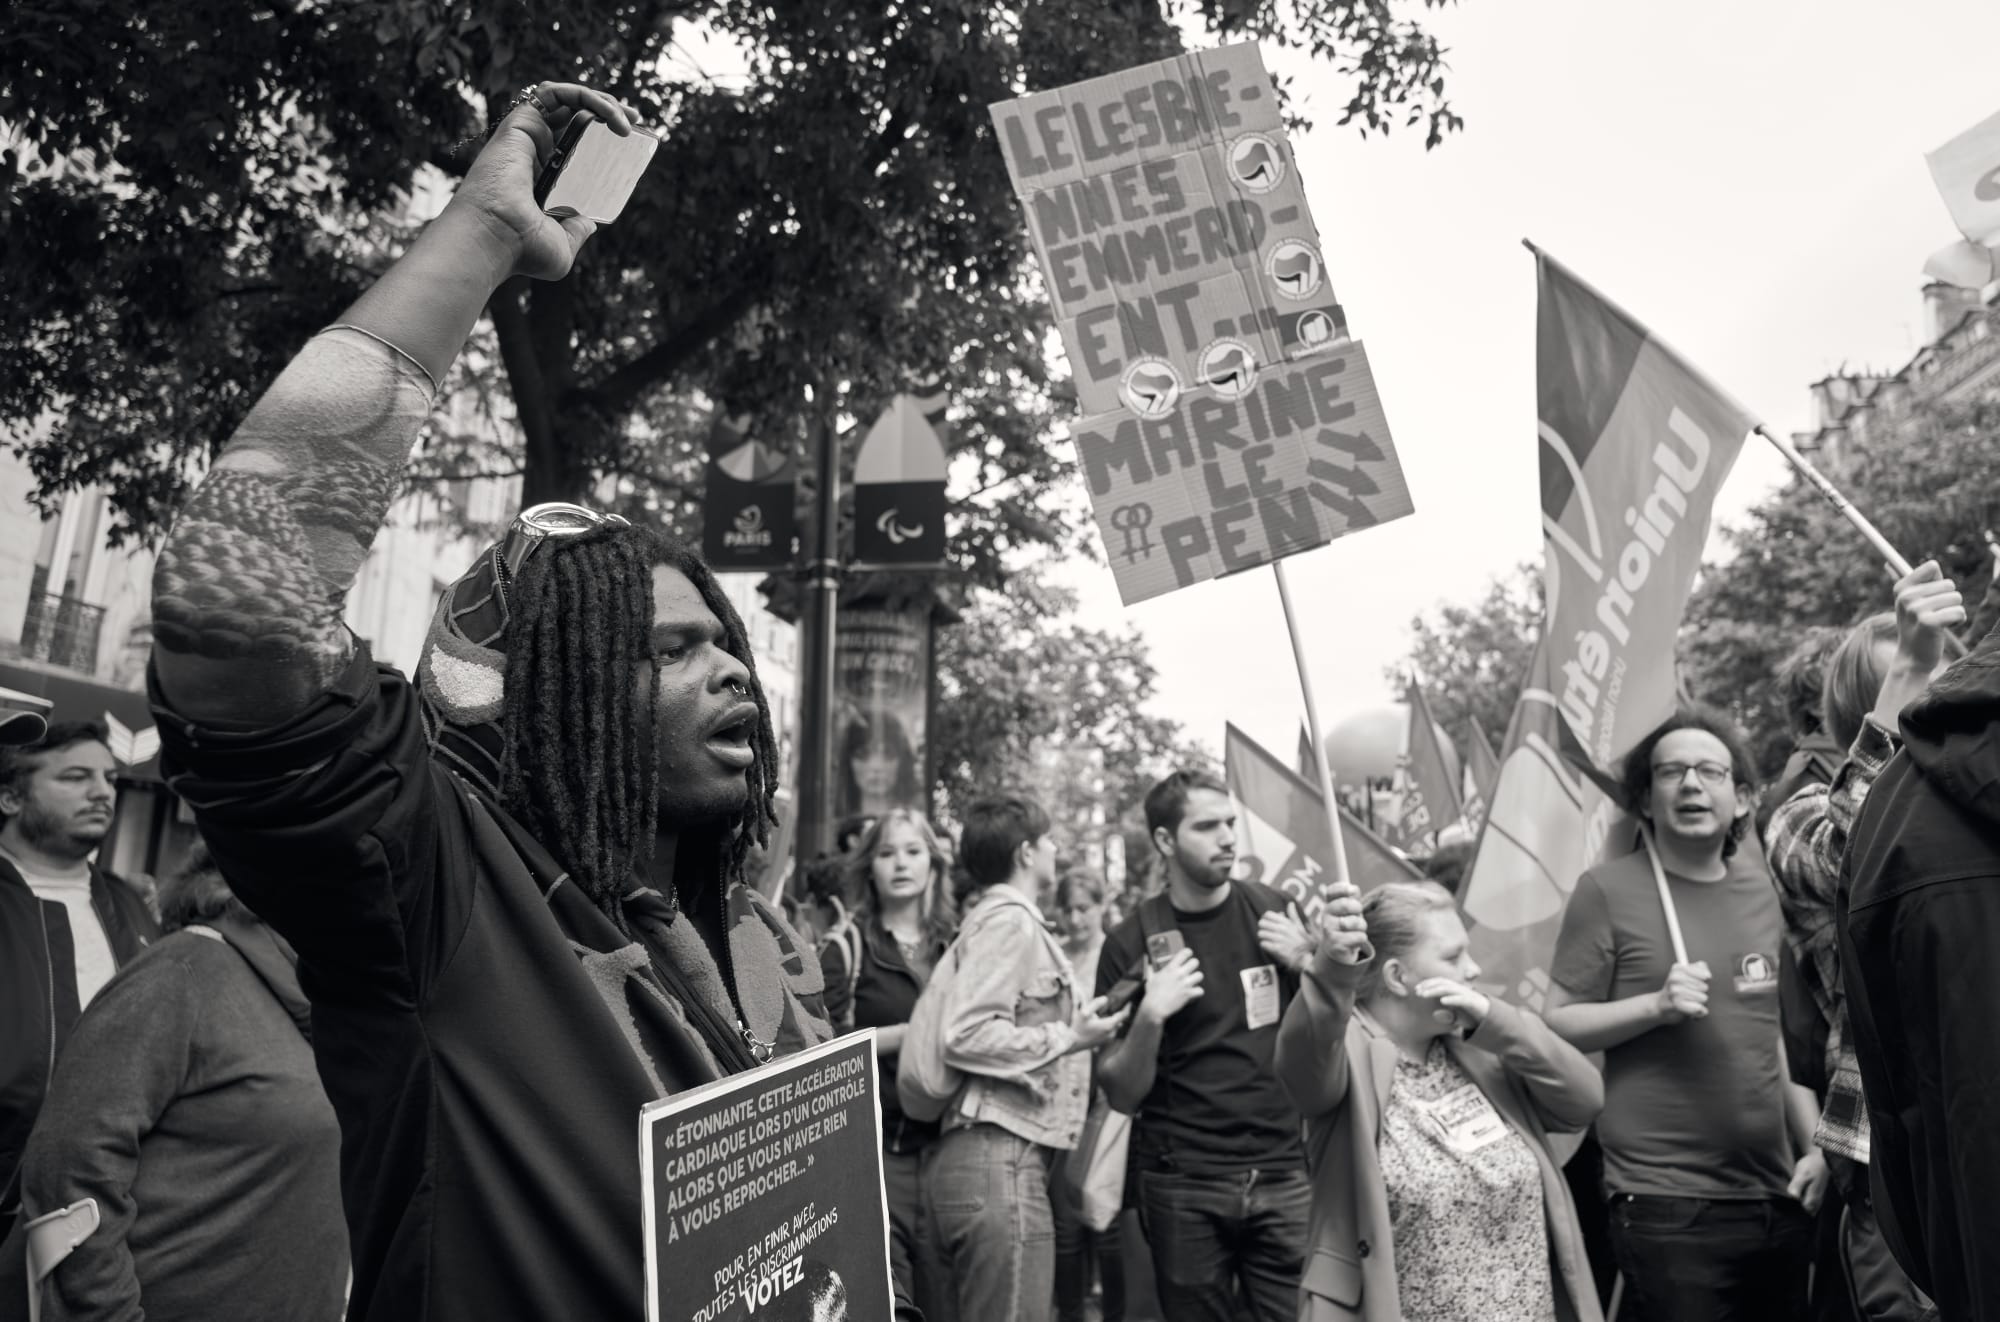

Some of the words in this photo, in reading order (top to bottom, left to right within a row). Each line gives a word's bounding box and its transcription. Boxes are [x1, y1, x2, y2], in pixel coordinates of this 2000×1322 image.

[1034, 158, 1187, 245] NNES
[1077, 358, 1356, 497] MARINE
[1203, 443, 1283, 509] LE
[724, 530, 772, 547] PARIS
[1160, 486, 1322, 588] PEN
[665, 1133, 747, 1183] CARDIAQUE
[750, 1118, 780, 1148] LORS
[783, 1105, 810, 1133] D'UN
[812, 1078, 866, 1116] CONTRÔLE
[676, 1098, 757, 1149] ÉTONNANTE,
[758, 1083, 793, 1114] CETTE
[794, 1054, 864, 1098] ACCÉLÉRATION
[667, 1173, 714, 1214] ALORS
[717, 1158, 745, 1187] QUE
[747, 1144, 781, 1173] VOUS
[783, 1122, 822, 1155] N'AVEZ
[823, 1109, 848, 1135] RIEN
[668, 1217, 680, 1244] À
[681, 1203, 721, 1236] VOUS
[724, 1161, 806, 1214] REPROCHER...
[692, 1286, 736, 1322] TOUTES
[737, 1269, 758, 1298] LES
[760, 1207, 838, 1281] DISCRIMINATIONS
[714, 1256, 745, 1292] POUR
[748, 1241, 762, 1268] EN
[765, 1222, 790, 1254] FINIR
[792, 1202, 816, 1234] AVEC
[743, 1255, 805, 1314] VOTEZ
